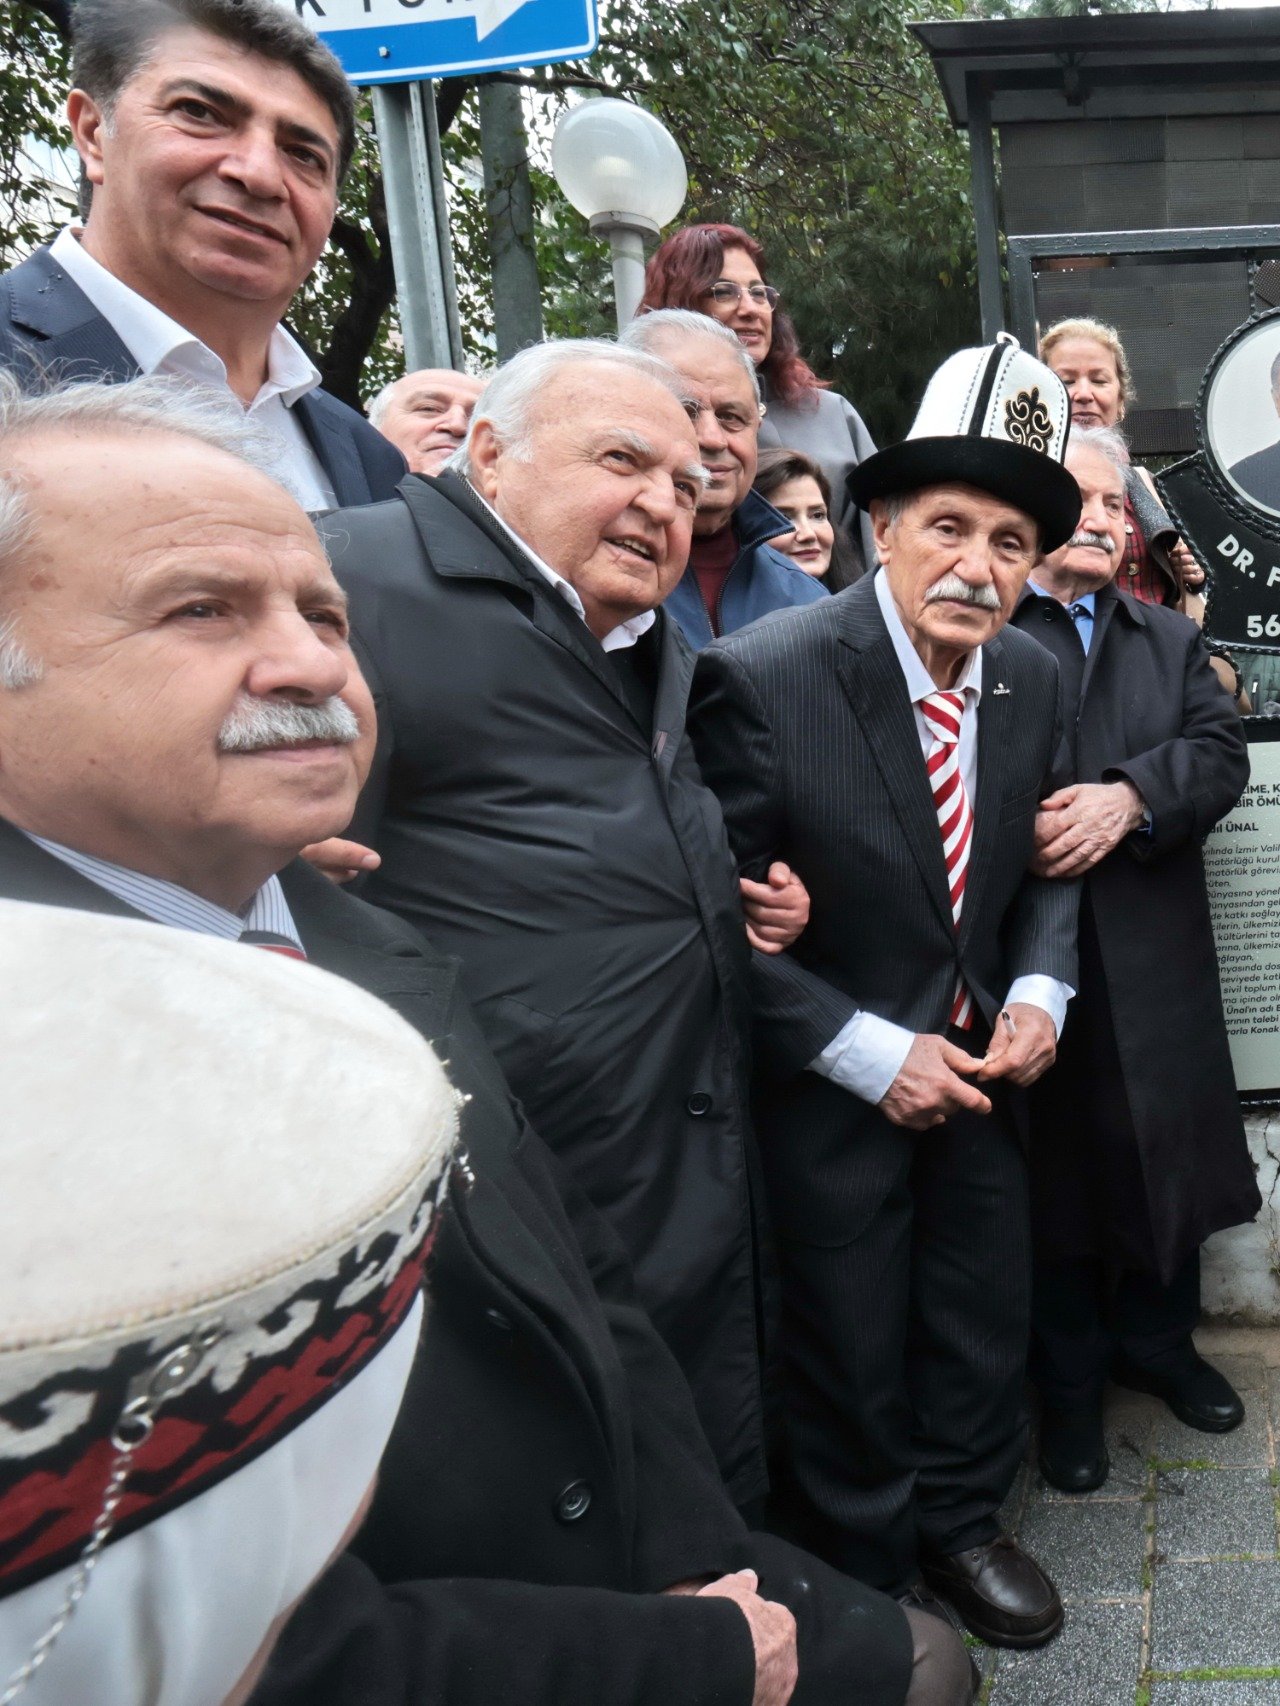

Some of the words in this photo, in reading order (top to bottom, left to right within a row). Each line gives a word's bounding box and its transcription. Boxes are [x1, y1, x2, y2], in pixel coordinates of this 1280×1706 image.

[1216, 533, 1256, 579] DR.
[1225, 820, 1259, 833] ÜNAL
[1235, 844, 1258, 854] İzmir
[1224, 911, 1248, 919] katkı
[1217, 931, 1268, 941] kültürlerini
[1220, 974, 1261, 984] seviyede
[1223, 985, 1242, 994] sivil
[1244, 984, 1276, 994] toplum
[1239, 995, 1268, 1005] içinde
[1259, 1005, 1274, 1013] adı
[1252, 1014, 1279, 1024] talebi
